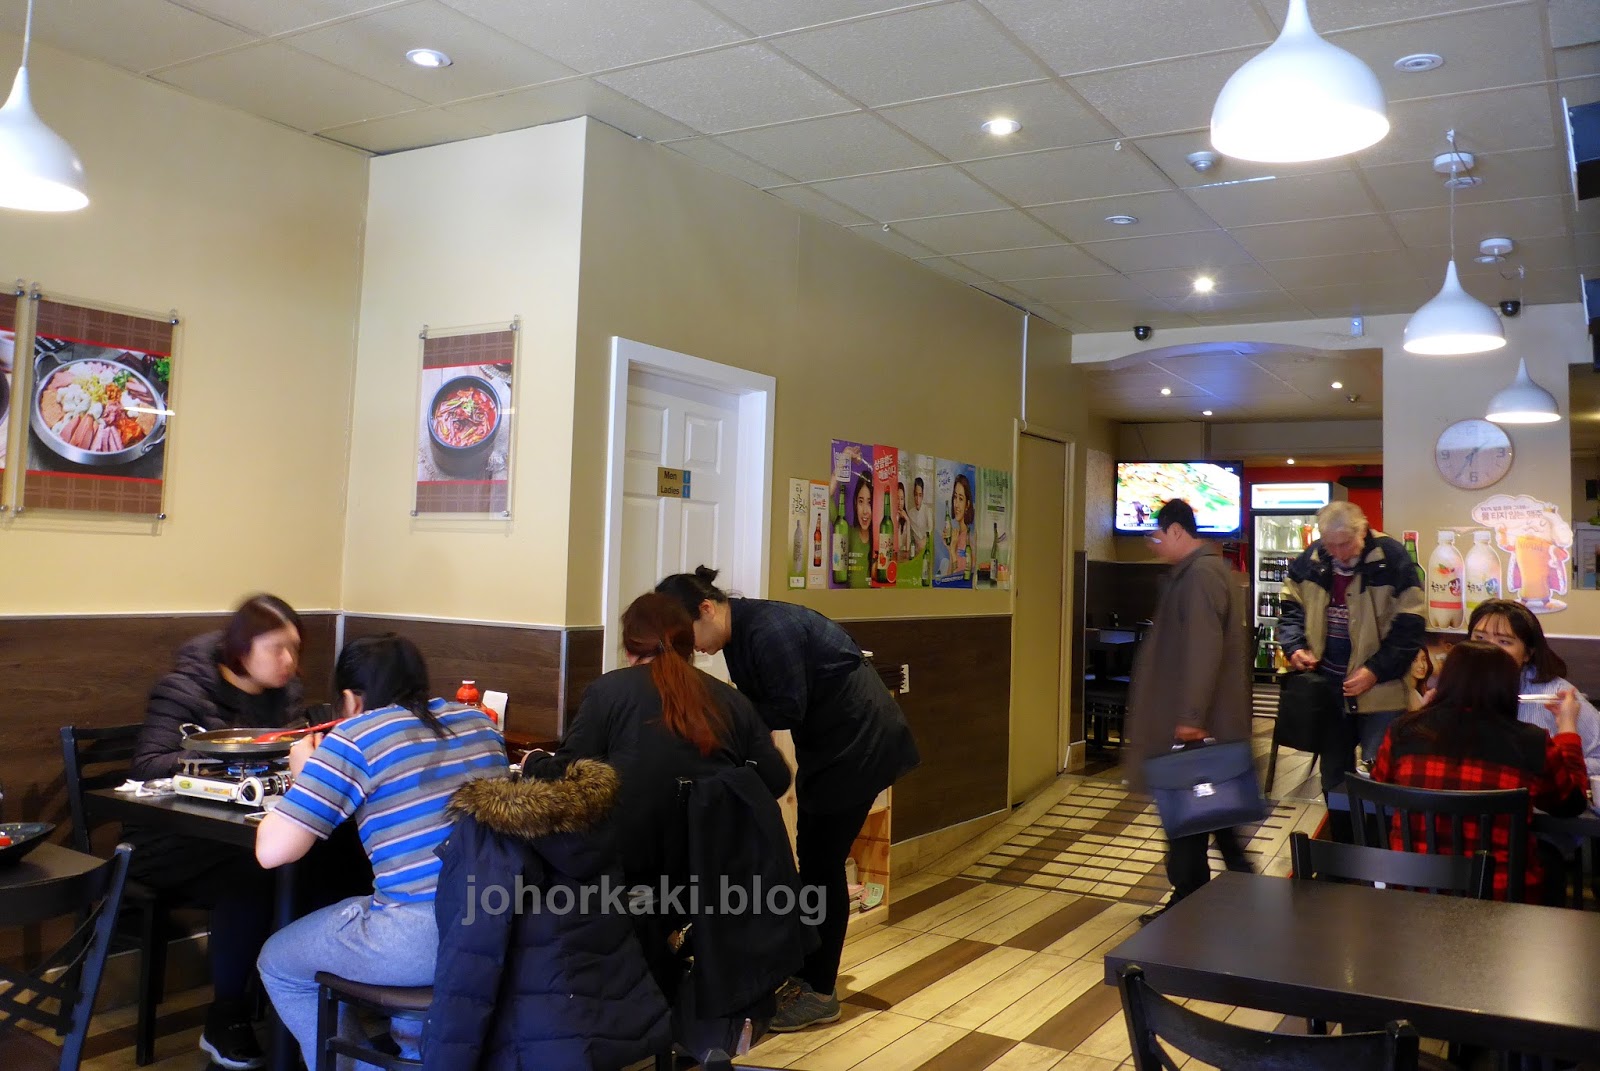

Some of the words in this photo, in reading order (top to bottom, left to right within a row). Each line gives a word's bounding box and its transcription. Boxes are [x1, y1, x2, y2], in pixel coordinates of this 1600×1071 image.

[1441, 449, 1450, 460] 9
[1496, 447, 1506, 458] 3
[664, 470, 677, 480] Men
[1469, 471, 1478, 482] 6
[660, 485, 680, 495] Ladies
[1481, 511, 1489, 520] 물
[1490, 510, 1507, 520] 타지
